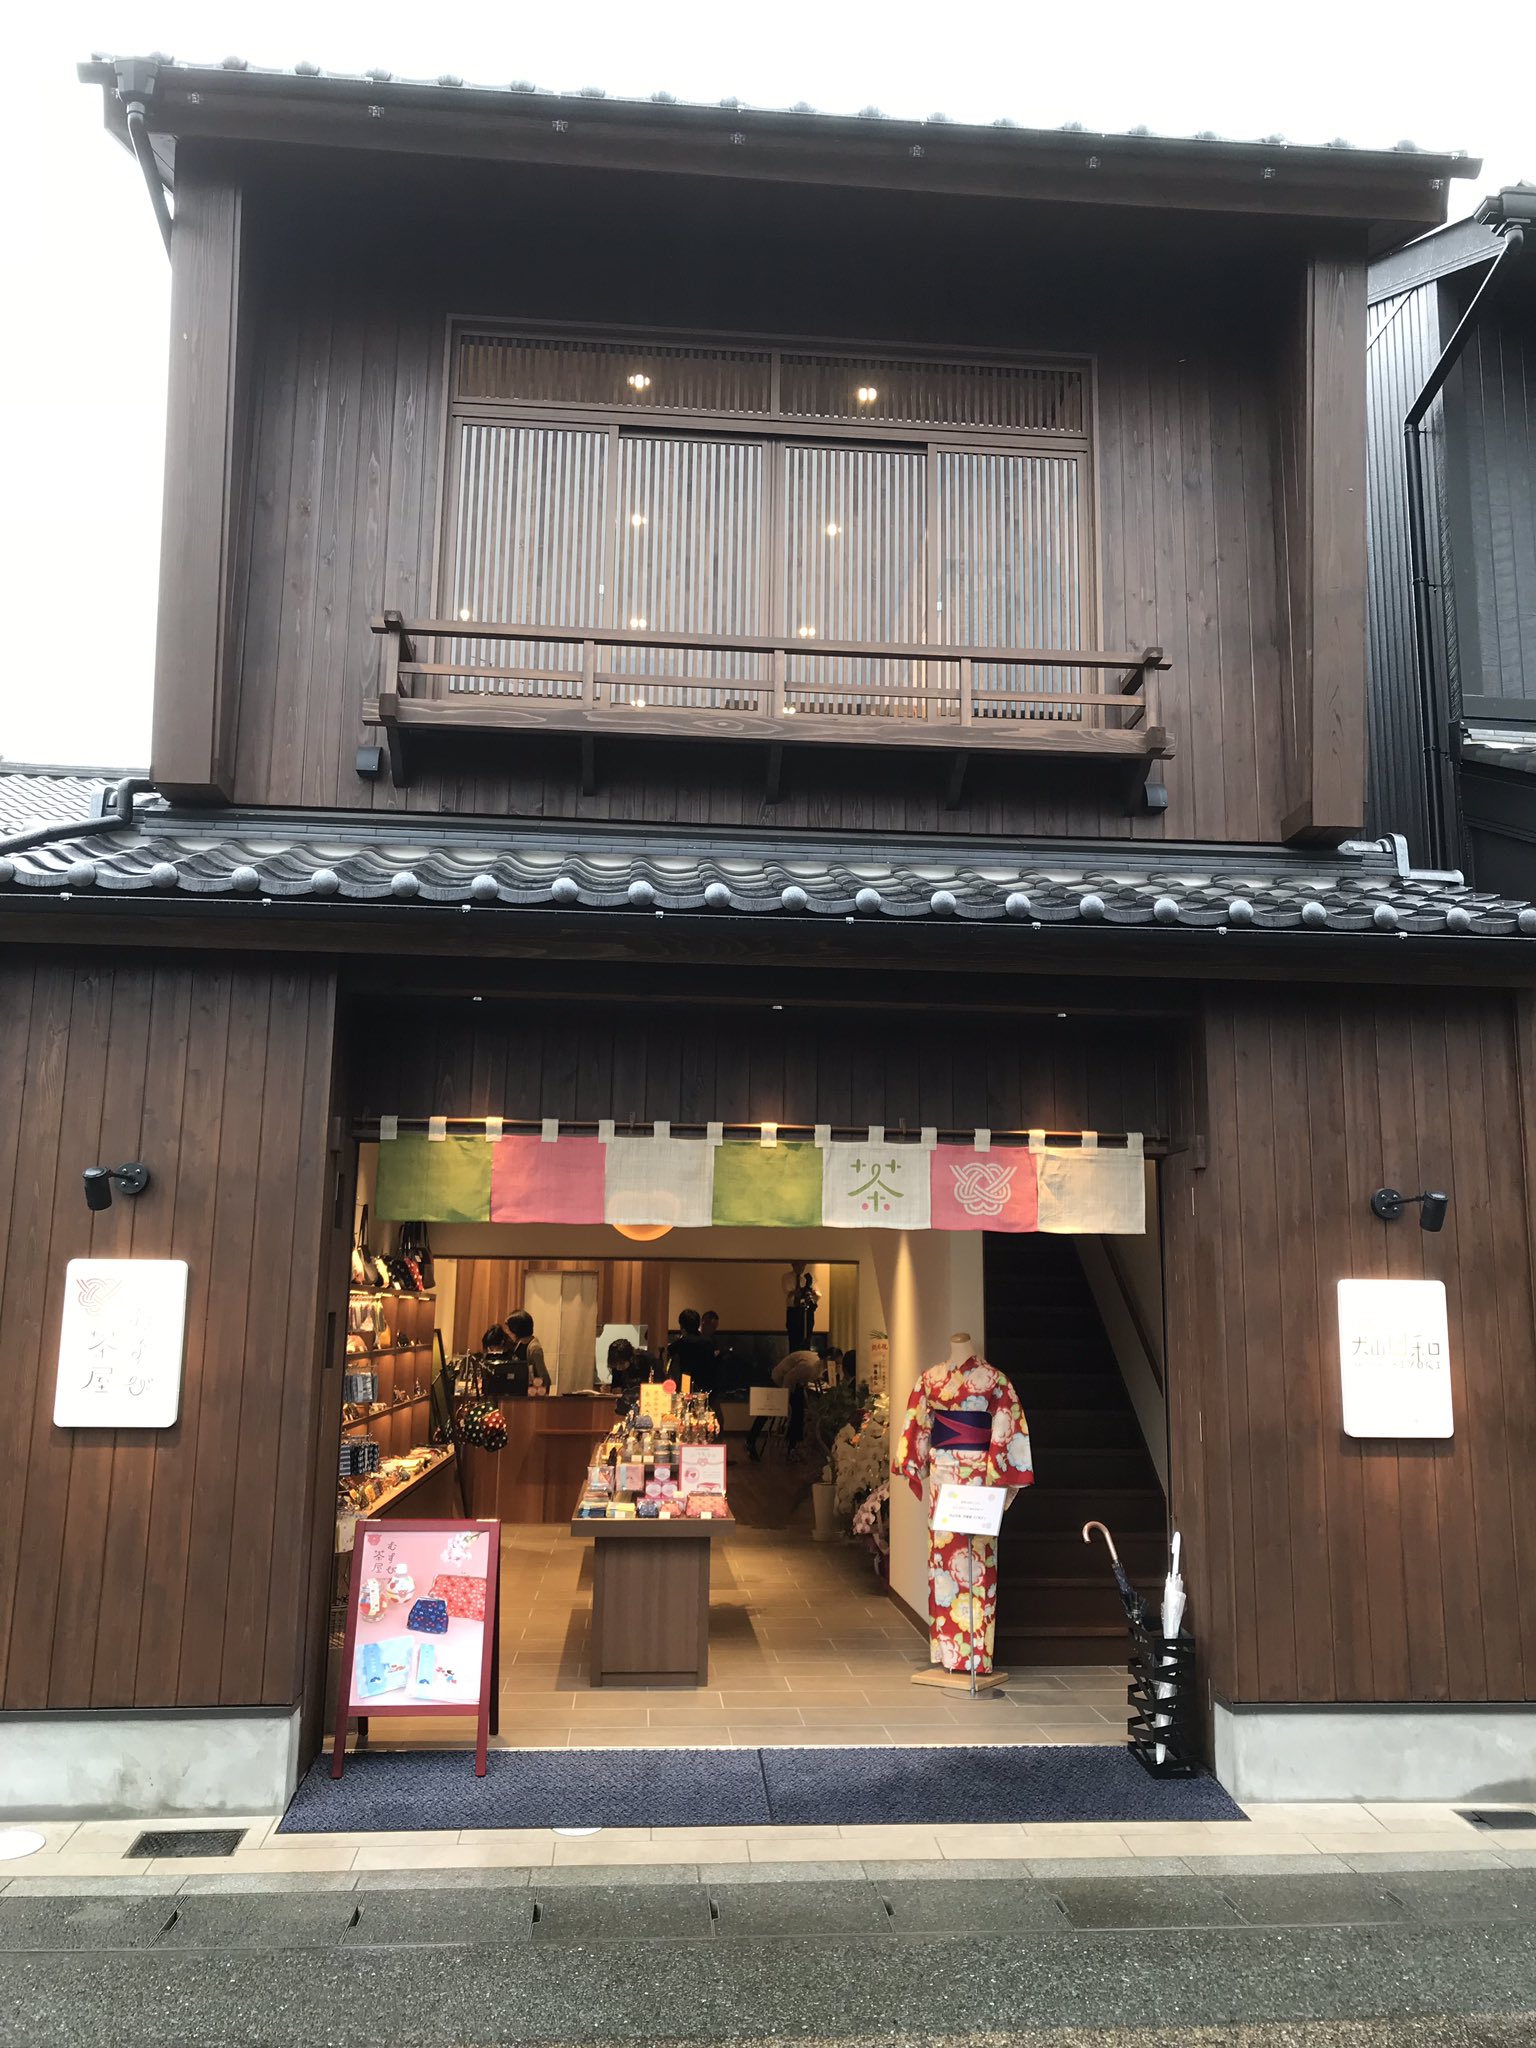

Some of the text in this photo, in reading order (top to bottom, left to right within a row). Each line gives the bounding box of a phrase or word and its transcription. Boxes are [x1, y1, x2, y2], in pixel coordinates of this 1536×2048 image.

[848, 1159, 904, 1212] 茶
[81, 1329, 118, 1393] 茶屋
[371, 1550, 385, 1574] 茶屋
